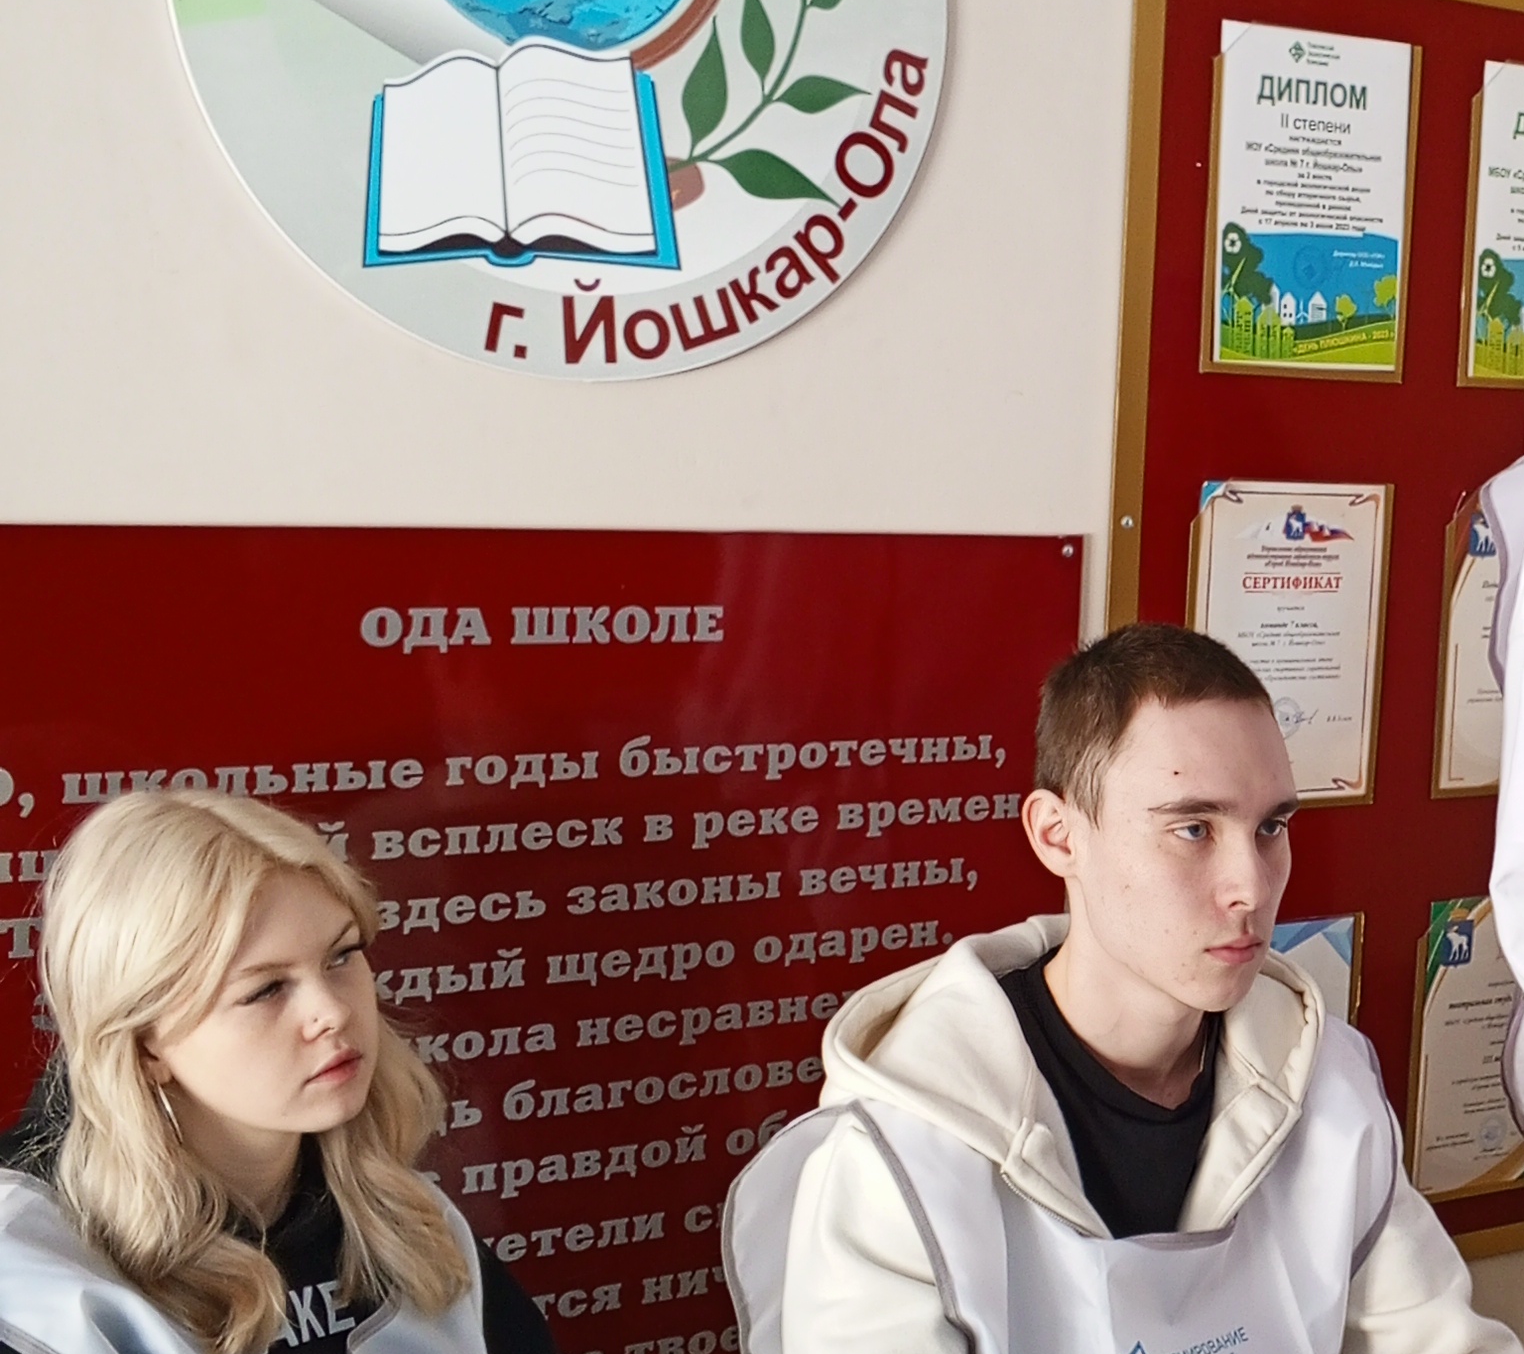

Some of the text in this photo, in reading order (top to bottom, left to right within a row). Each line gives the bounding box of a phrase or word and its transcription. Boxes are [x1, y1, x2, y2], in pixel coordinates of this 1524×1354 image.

[1257, 75, 1368, 111] ДИПЛОМ
[1293, 117, 1352, 135] степени
[482, 47, 930, 366] г. Йошкар-Ола
[1242, 576, 1343, 590] СЕРТИФИКАТ
[360, 605, 724, 654] ОДА ШКОЛЕ
[445, 751, 598, 790] годы
[619, 734, 1006, 780] быстротечны,
[371, 816, 623, 861] всплеск
[643, 814, 673, 843] в
[692, 805, 819, 849] реке
[837, 793, 1021, 837] времен
[377, 857, 978, 935] здесь законы вечны,
[546, 940, 735, 981] щедро
[754, 920, 954, 967] одарен.
[415, 992, 849, 1064] кола несравне
[503, 1056, 823, 1121] благослове
[462, 1125, 706, 1199] правдой
